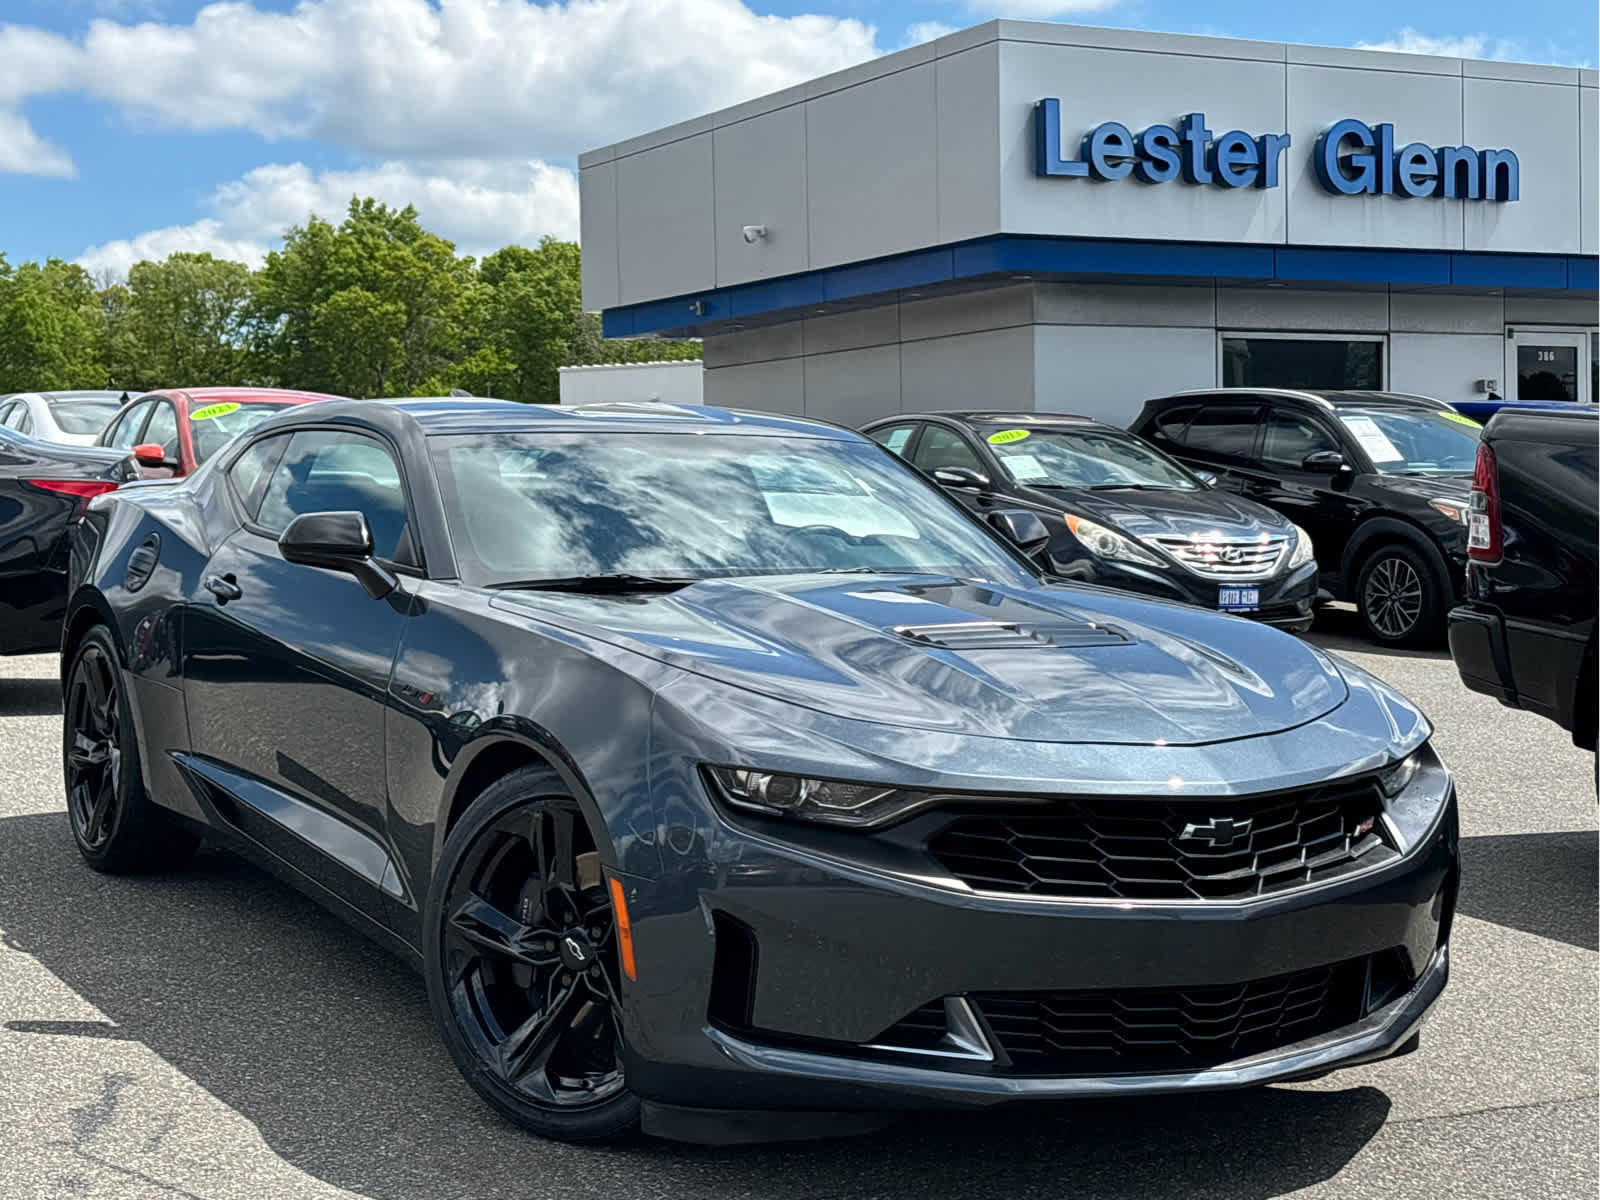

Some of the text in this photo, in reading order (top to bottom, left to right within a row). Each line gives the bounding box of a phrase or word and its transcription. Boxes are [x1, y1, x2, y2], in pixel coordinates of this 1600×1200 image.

[1036, 98, 1520, 201] Lester Glenn
[1218, 590, 1240, 605] LESTER
